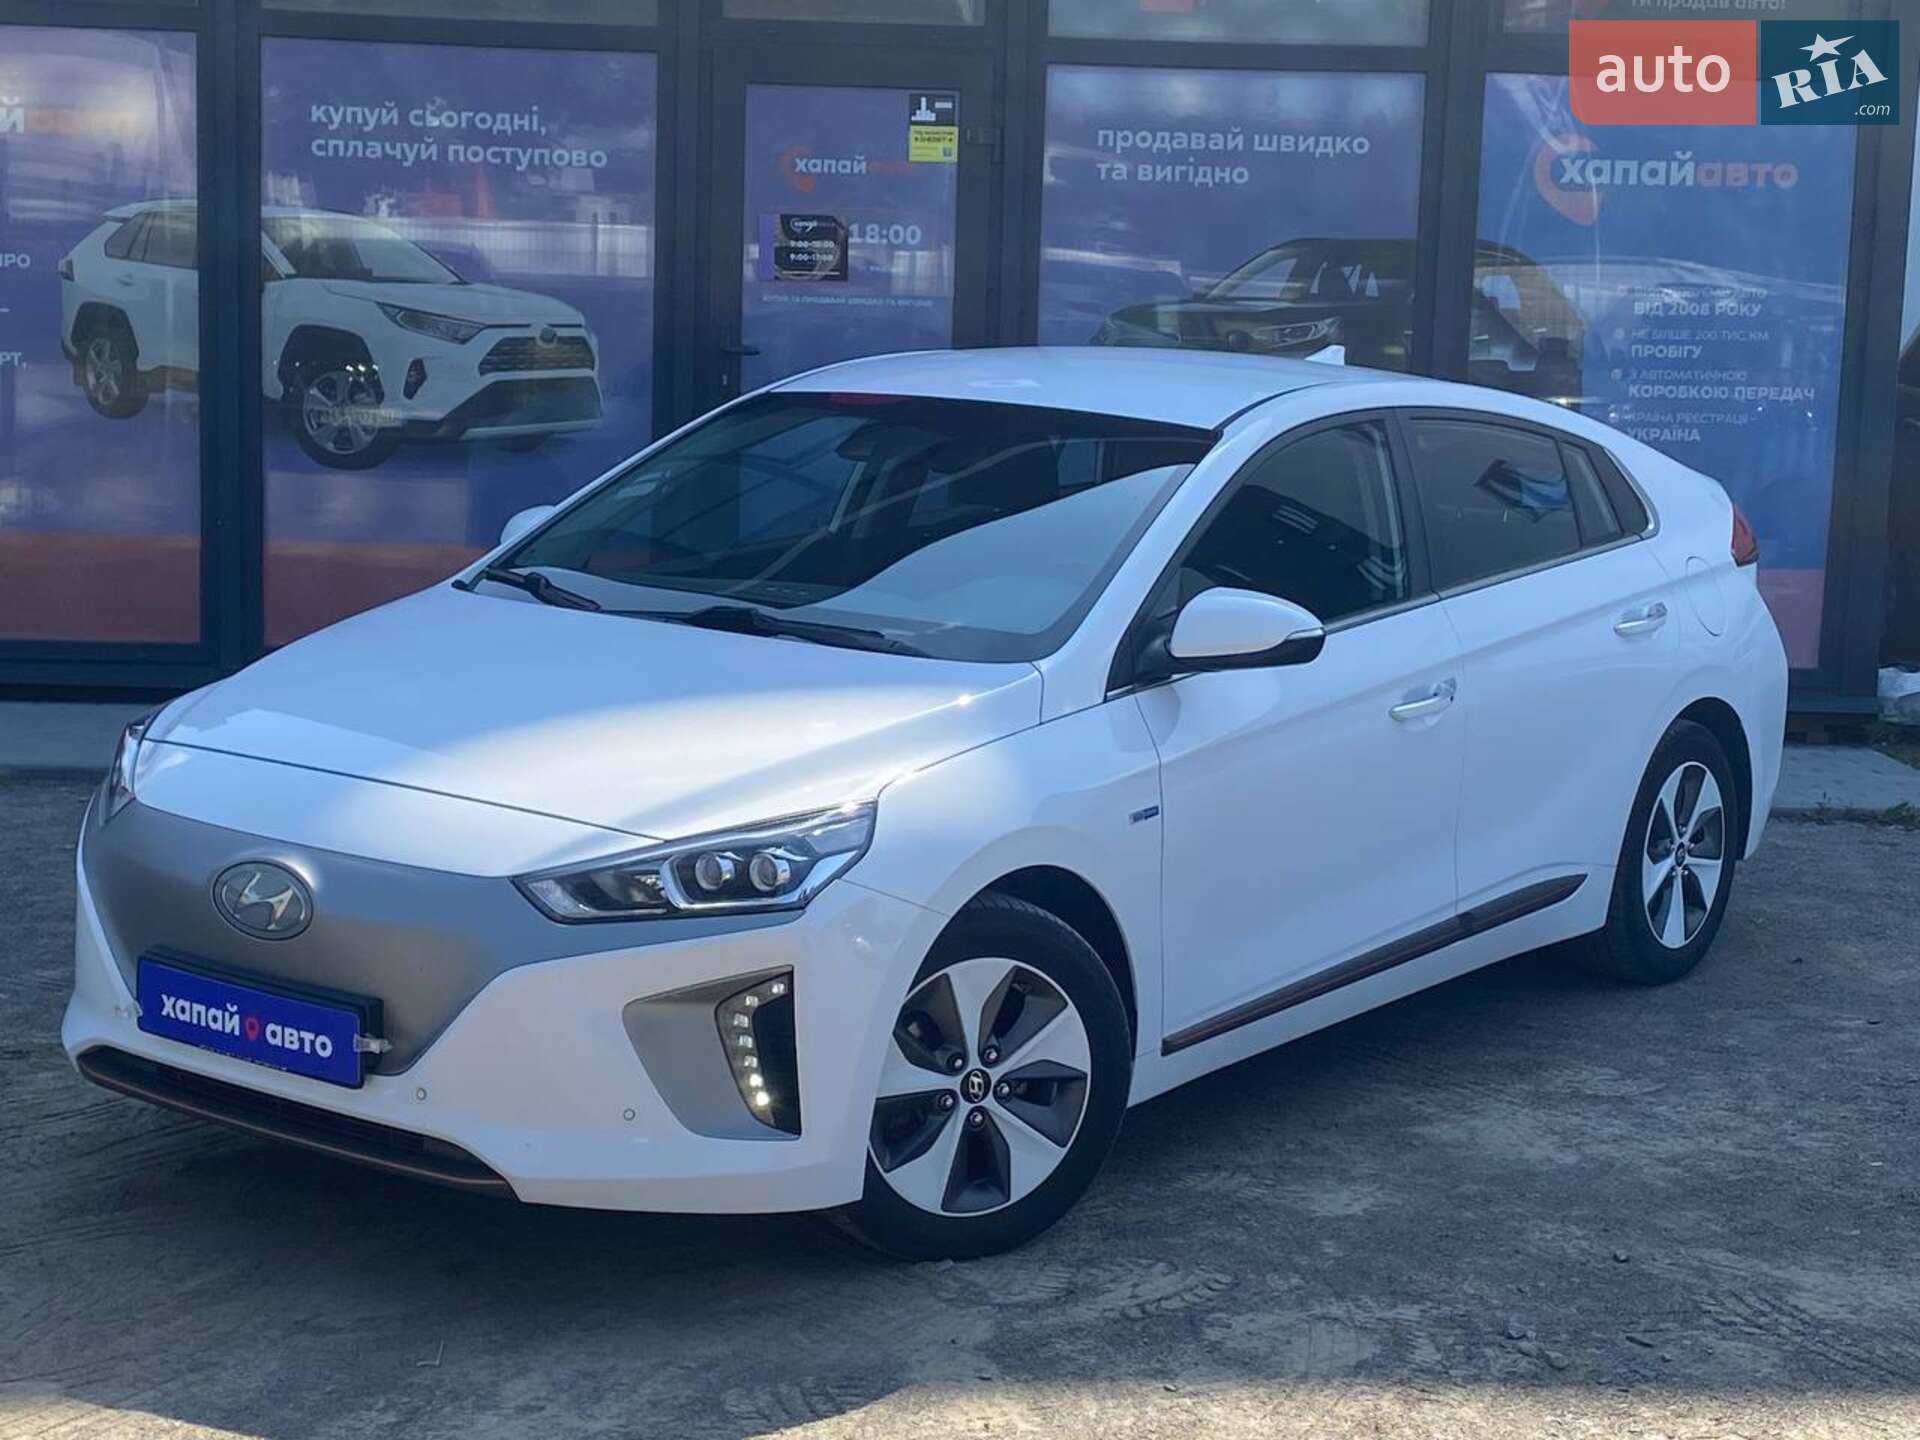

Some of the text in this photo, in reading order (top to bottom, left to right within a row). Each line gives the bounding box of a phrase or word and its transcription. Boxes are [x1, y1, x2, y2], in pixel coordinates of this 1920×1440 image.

[311, 100, 547, 136] купуй сьогодні,
[311, 135, 608, 171] сплачуй поступово
[1097, 126, 1371, 158] продавай швидко
[794, 154, 867, 174] хапай
[1096, 156, 1249, 188] та вигідно
[849, 223, 922, 245] 18:00
[1634, 301, 1762, 318] ВІД 2008 РОКУ
[1631, 344, 1702, 359] ПРОБІГУ
[1628, 384, 1815, 402] КОРОБКОЮ ПЕРЕДАЧ
[1627, 424, 1701, 442] УКРАЇНА
[161, 994, 240, 1036] хапай
[265, 1021, 333, 1059] авто
